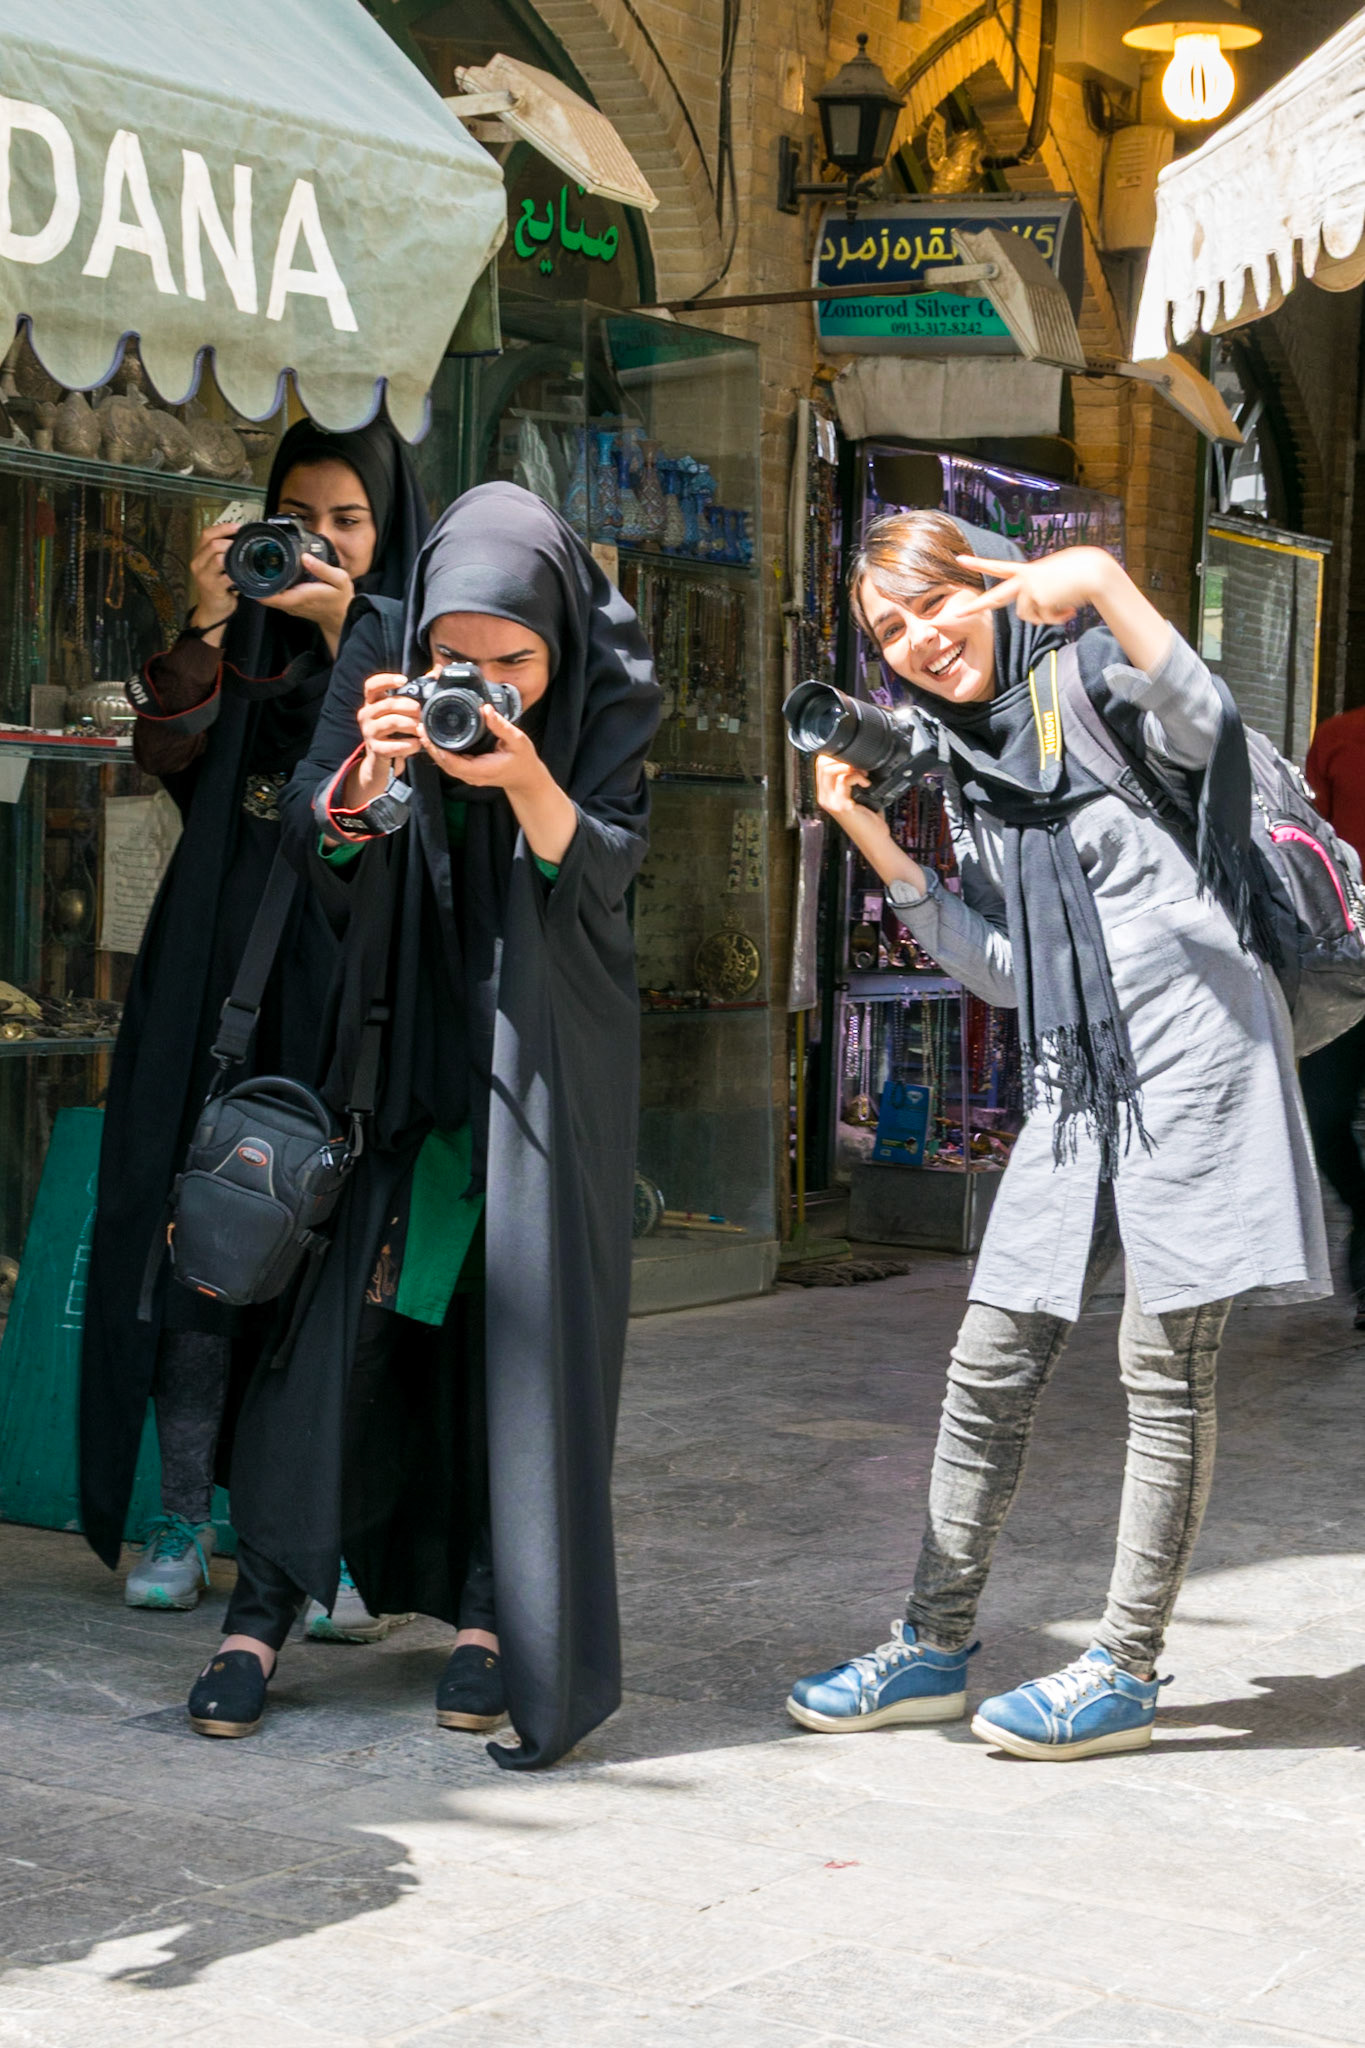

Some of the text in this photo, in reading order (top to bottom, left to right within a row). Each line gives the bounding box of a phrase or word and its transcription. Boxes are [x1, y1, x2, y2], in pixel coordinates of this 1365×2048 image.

[0, 95, 359, 332] DANA
[514, 184, 619, 273] صنایع
[820, 228, 890, 270] زمرد
[821, 298, 909, 318] Zomorod
[915, 299, 971, 318] Silver
[891, 322, 983, 335] 0913-317-8242
[1042, 709, 1057, 755] Nikon
